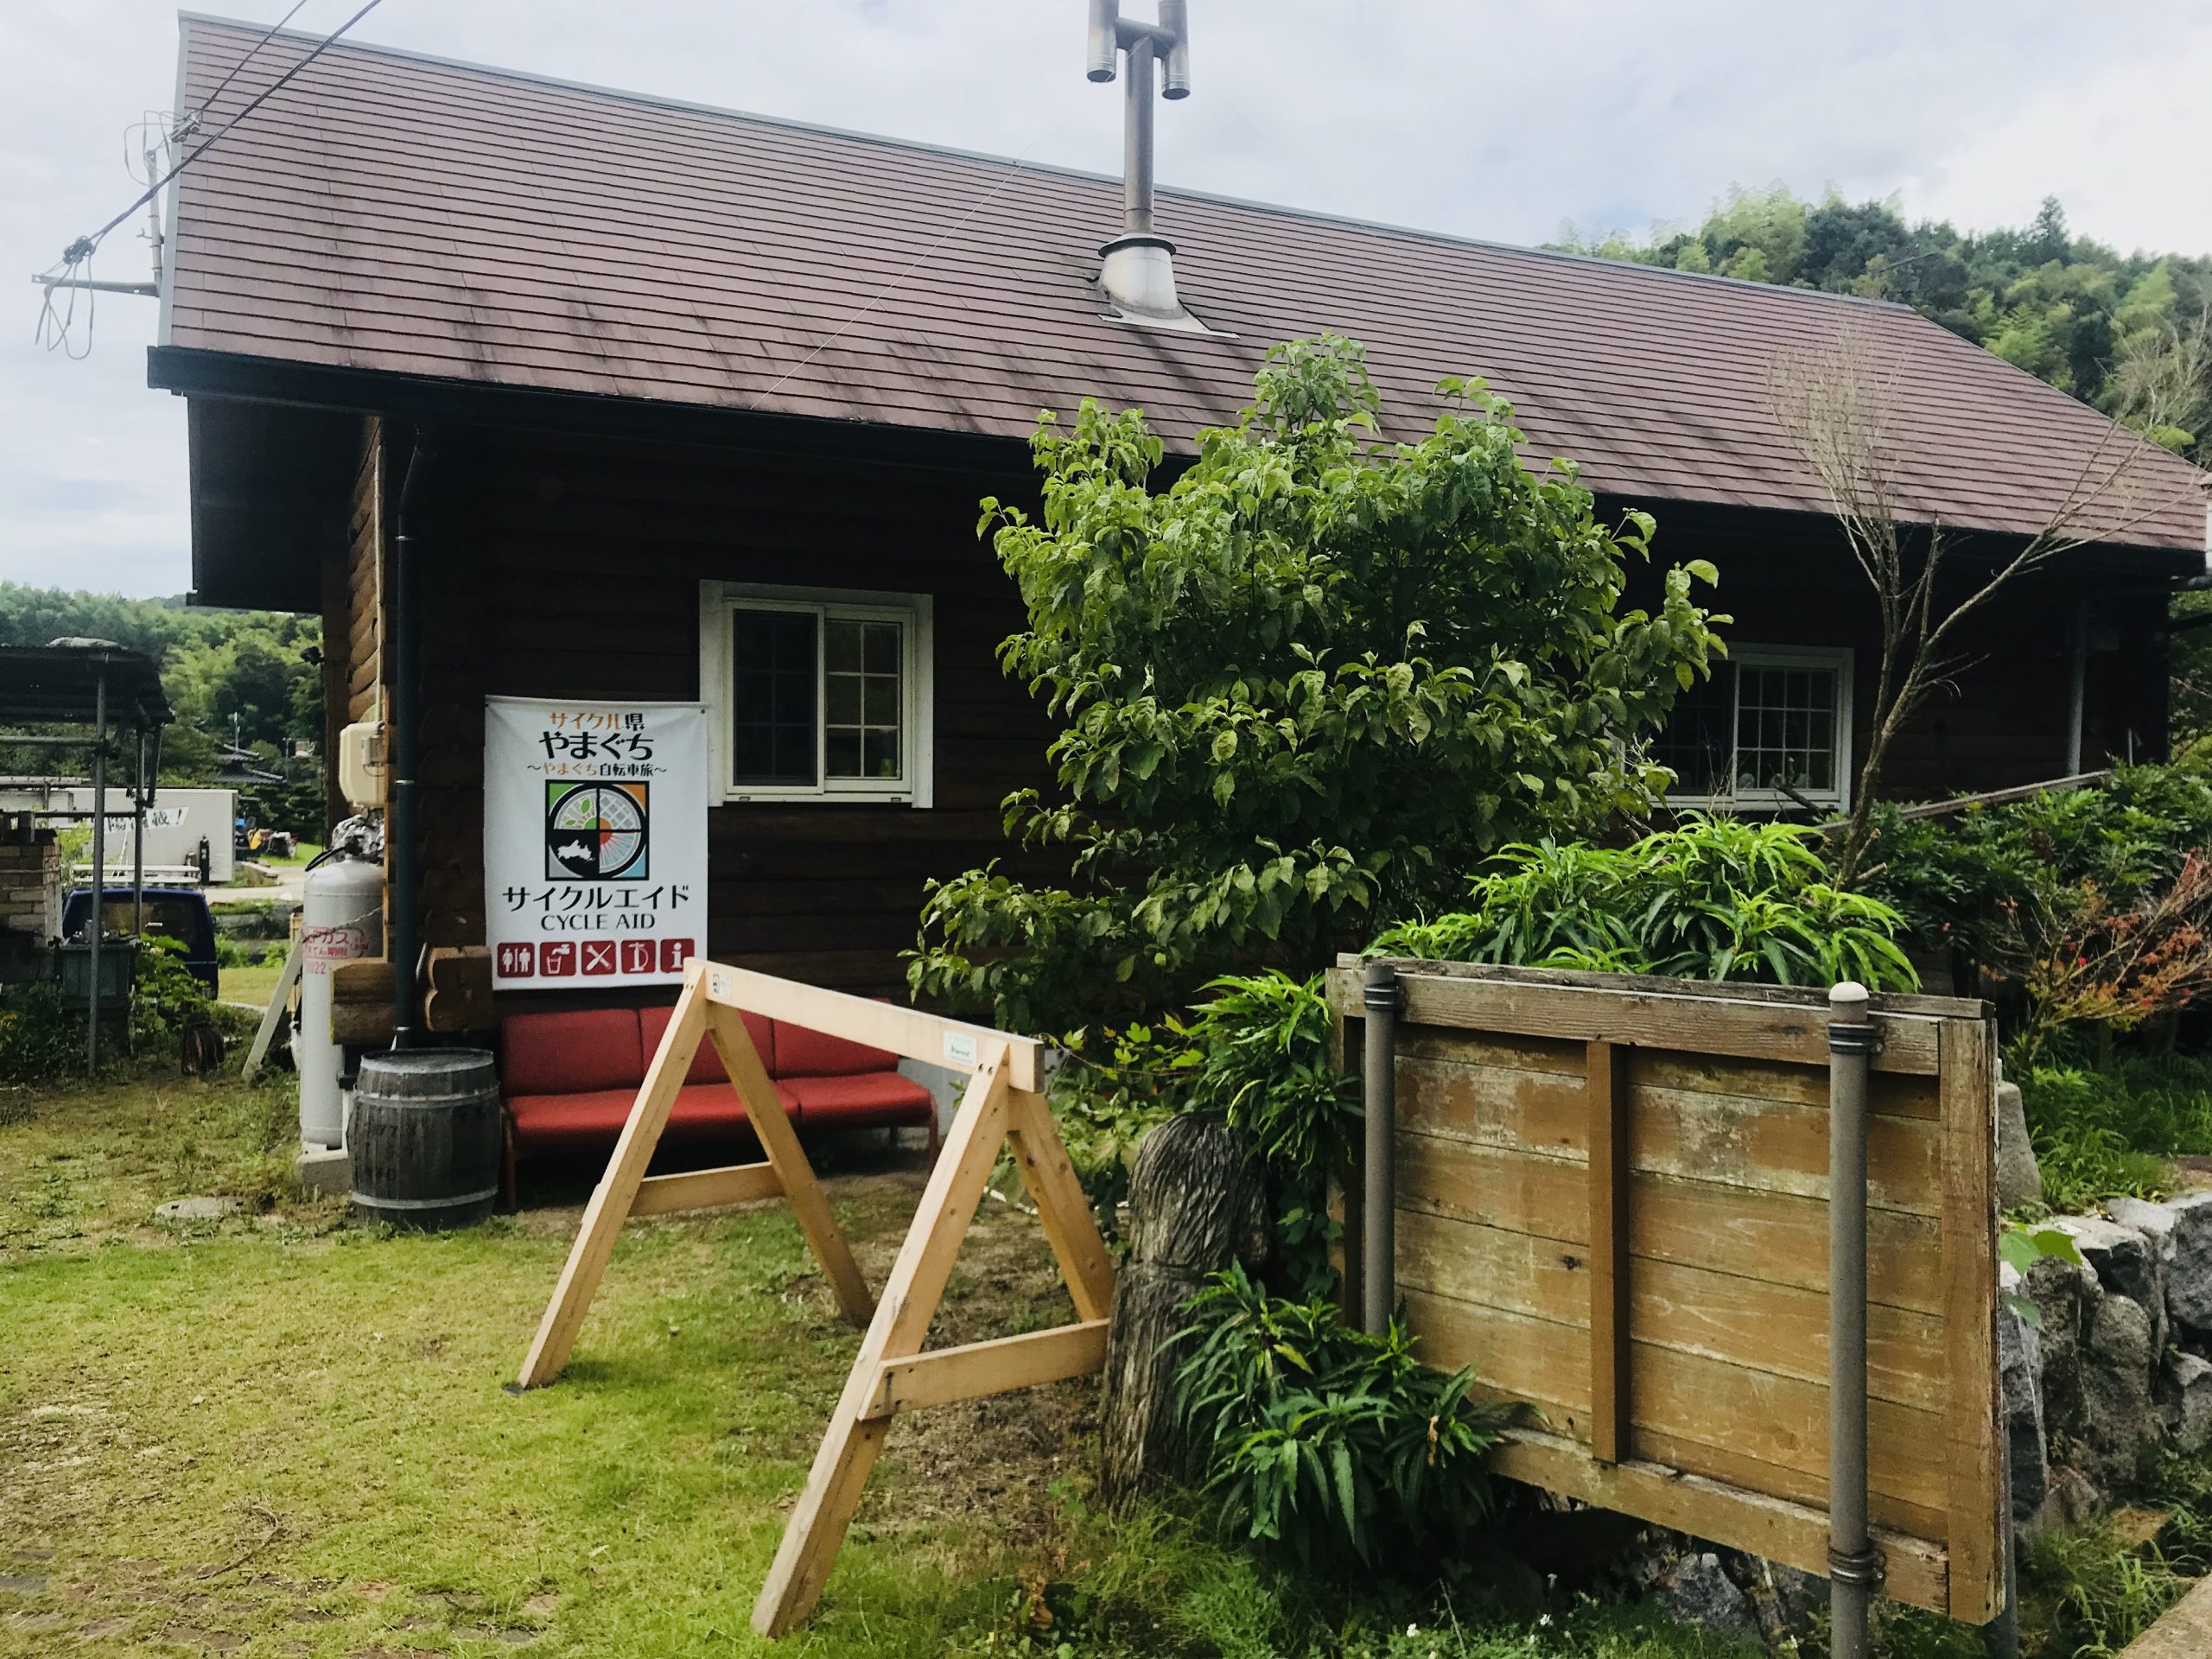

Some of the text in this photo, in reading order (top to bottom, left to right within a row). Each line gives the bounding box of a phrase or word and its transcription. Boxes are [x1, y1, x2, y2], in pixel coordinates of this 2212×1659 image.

[550, 712, 645, 731] サイクル県
[538, 731, 654, 760] やまぐち
[502, 885, 690, 912] サイクルエイド
[540, 912, 655, 931] CYCLE AID
